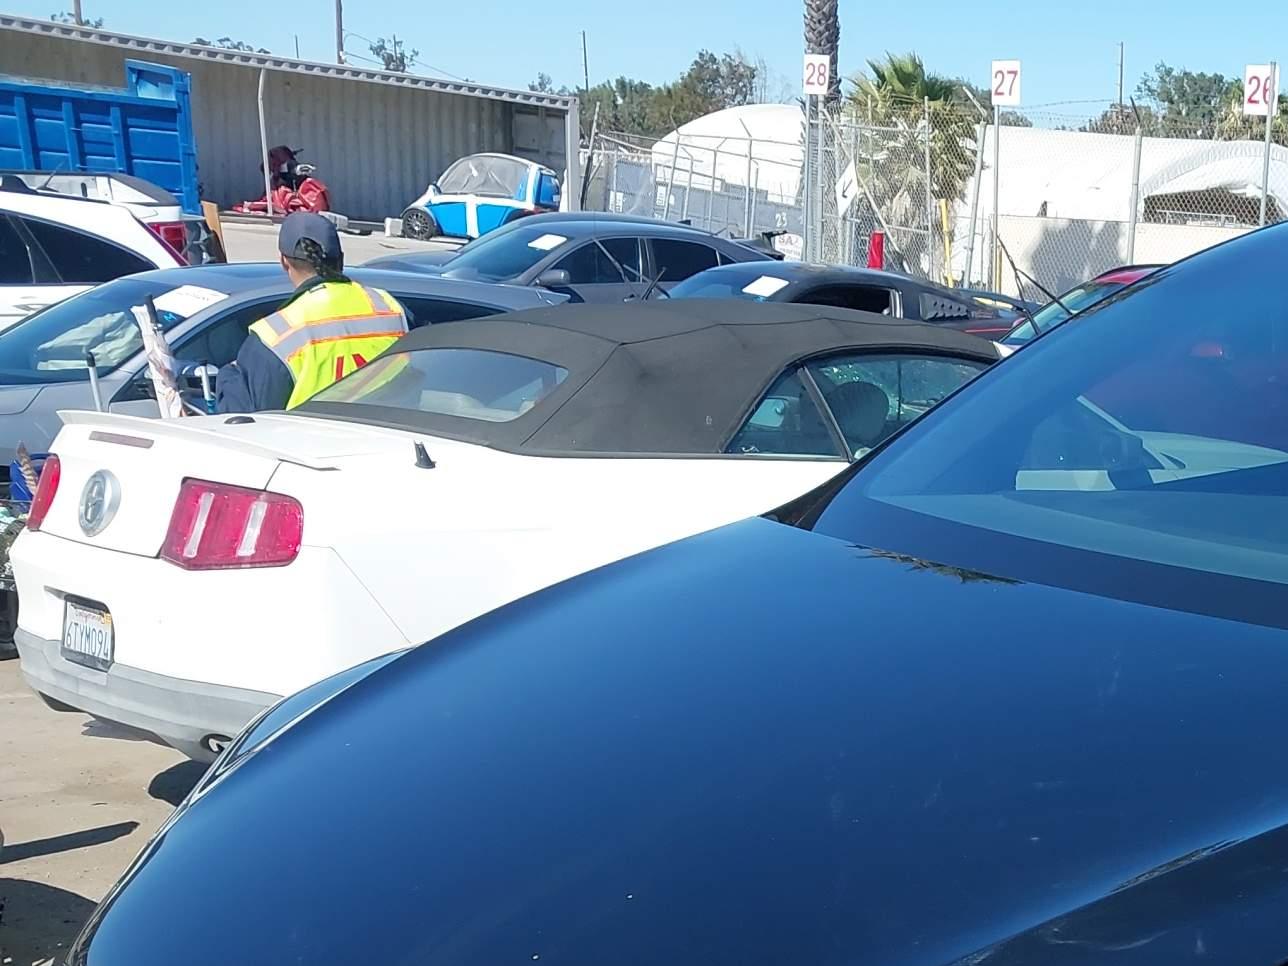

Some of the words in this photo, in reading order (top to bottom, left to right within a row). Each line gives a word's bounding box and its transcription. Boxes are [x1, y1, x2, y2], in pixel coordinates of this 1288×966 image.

[806, 62, 827, 86] 28
[994, 70, 1018, 96] 27
[1247, 75, 1275, 105] 26
[65, 621, 110, 658] 6TYM094
